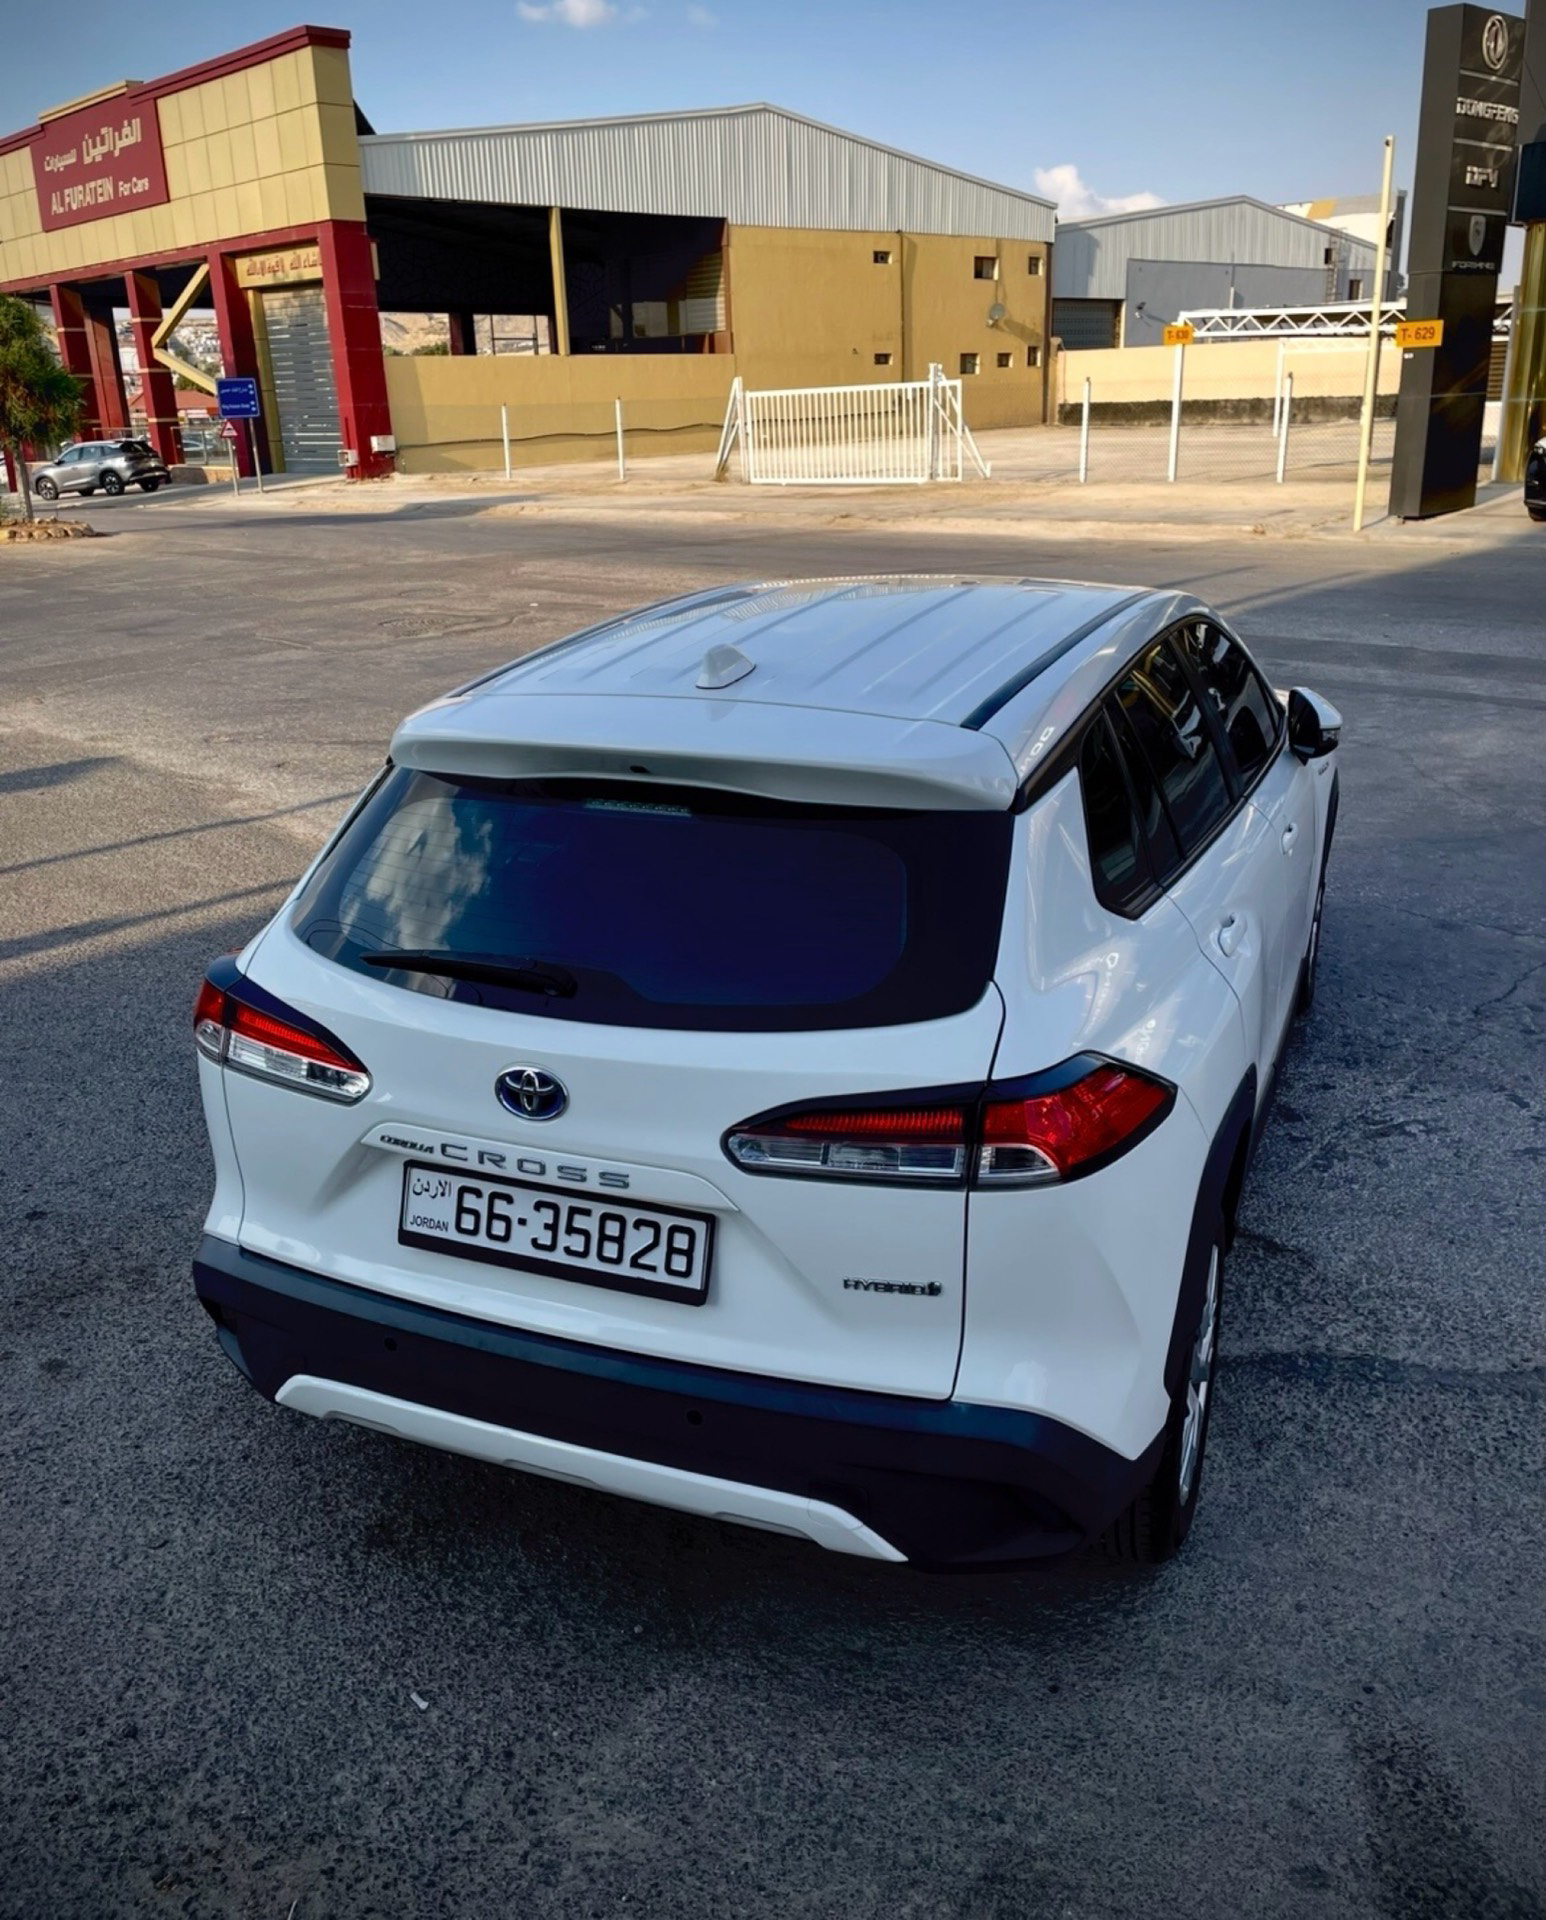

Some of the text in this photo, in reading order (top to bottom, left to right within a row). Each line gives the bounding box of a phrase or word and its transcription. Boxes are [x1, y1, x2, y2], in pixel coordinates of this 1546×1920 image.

[82, 117, 142, 165] الفراتين
[64, 175, 114, 212] FURATEIN
[118, 181, 130, 197] For
[131, 176, 149, 194] Cars
[1414, 326, 1435, 340] 629
[441, 1142, 630, 1190] CROSS
[410, 1214, 449, 1233] JORDAN
[455, 1185, 697, 1279] 66-35828
[843, 1278, 926, 1296] HYBRID
